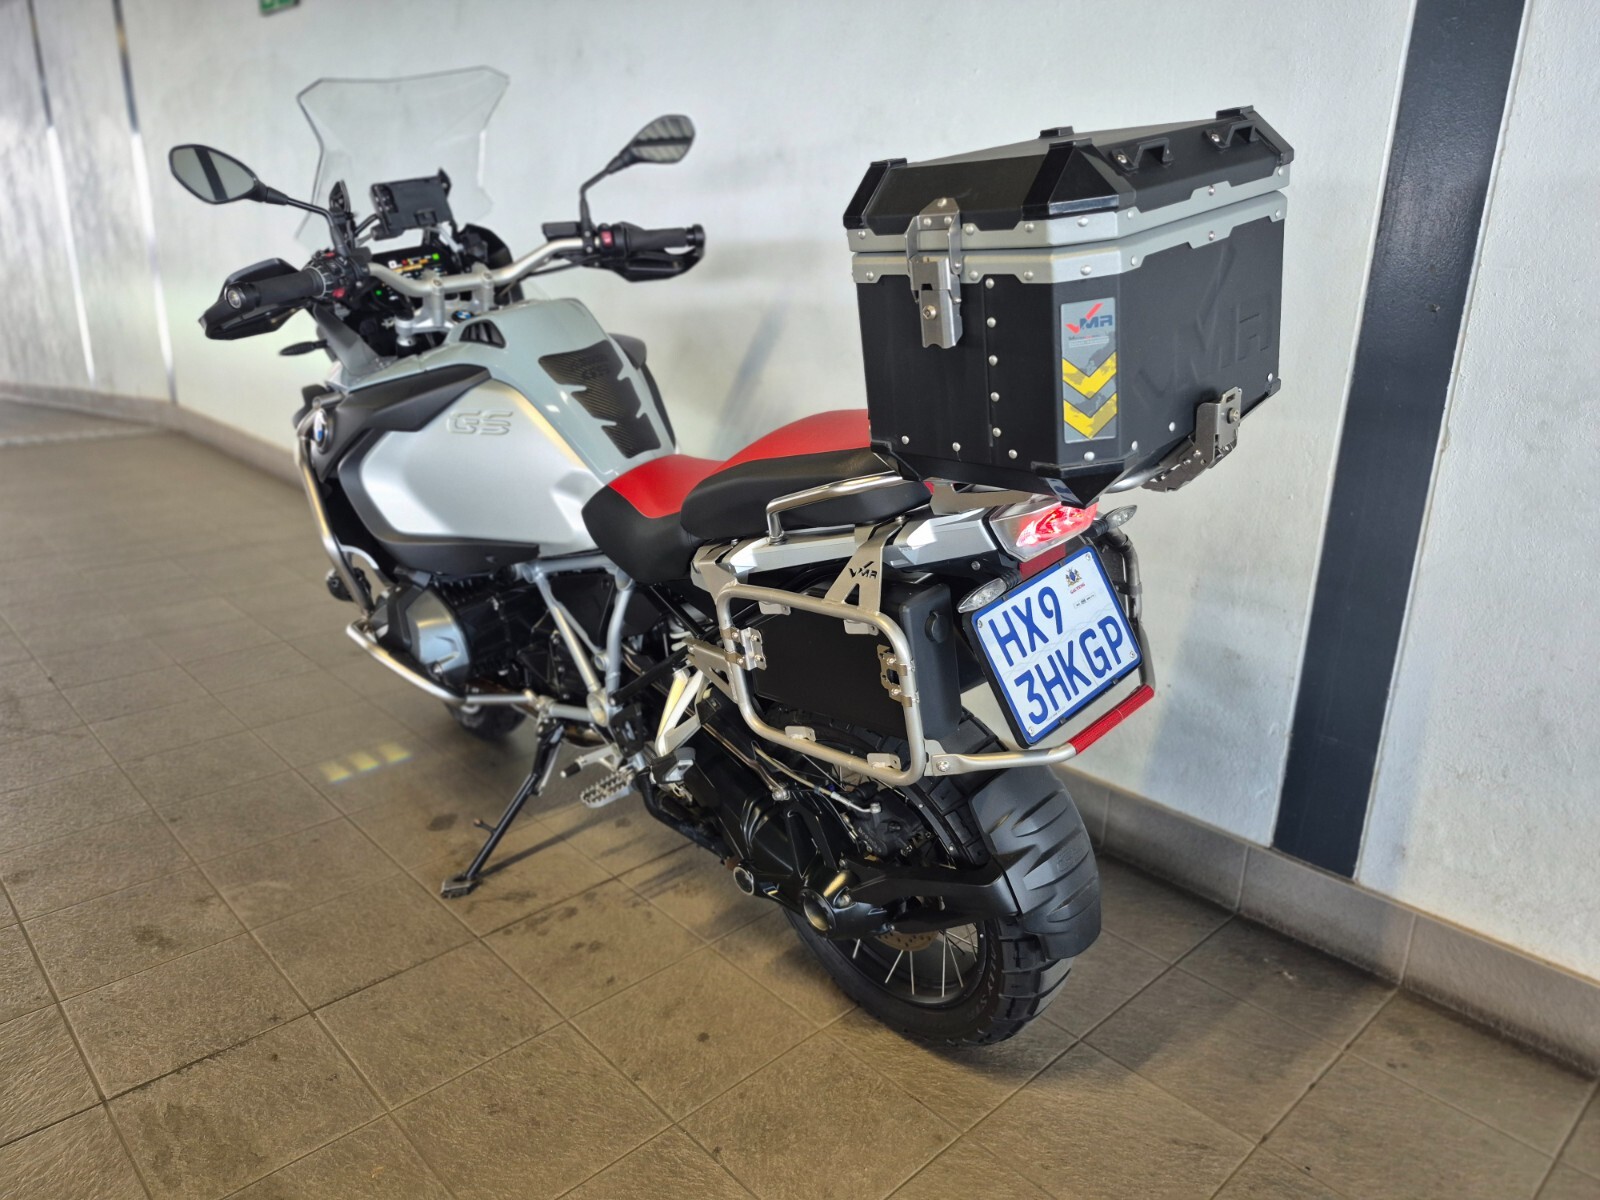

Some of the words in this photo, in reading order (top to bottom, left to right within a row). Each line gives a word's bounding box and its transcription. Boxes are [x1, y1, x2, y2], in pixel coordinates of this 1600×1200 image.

[1065, 302, 1113, 334] VMR
[446, 410, 513, 436] GS
[848, 561, 878, 579] VMR
[988, 586, 1063, 667] HX9
[1013, 615, 1123, 725] 3HKGP
